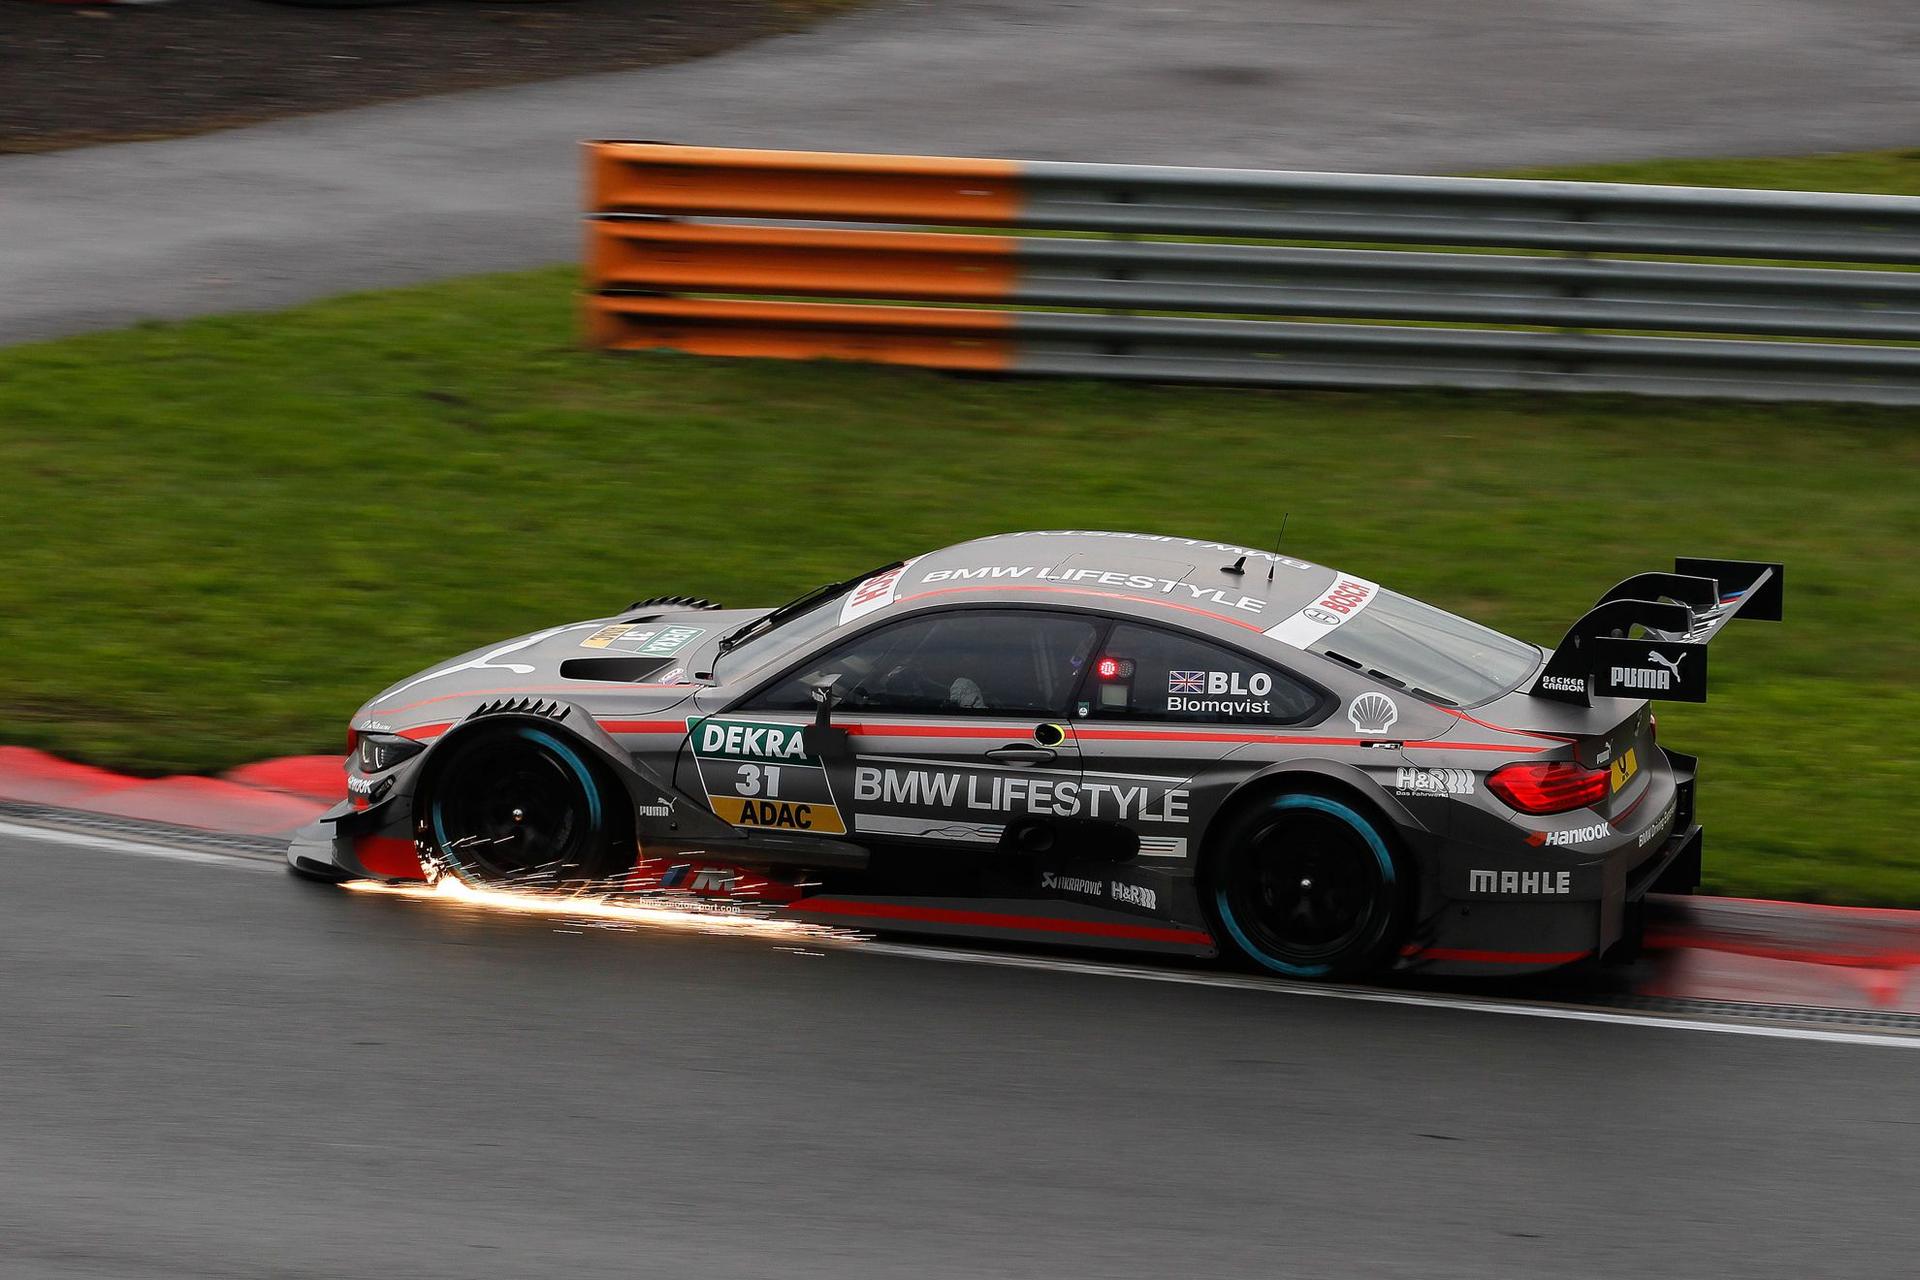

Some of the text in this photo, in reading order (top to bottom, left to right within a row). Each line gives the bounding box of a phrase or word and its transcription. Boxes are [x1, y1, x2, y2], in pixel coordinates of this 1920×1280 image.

[921, 566, 1267, 614] BMW LIFESTYLE
[1319, 580, 1371, 615] BOSCH
[1207, 671, 1273, 697] BLO
[1542, 675, 1584, 686] BECKER
[1542, 682, 1585, 693] CARBON
[1611, 666, 1670, 690] PUMA
[1166, 696, 1271, 716] Blomqvist
[702, 724, 807, 760] DEKRA
[735, 763, 781, 798] 31
[1395, 767, 1449, 792] H&R
[853, 766, 1191, 823] BMW LIFESTYLE
[640, 805, 669, 817] PUMA
[739, 800, 813, 830] ADAC
[1111, 881, 1147, 906] H&R
[1469, 869, 1571, 894] MAHLE
